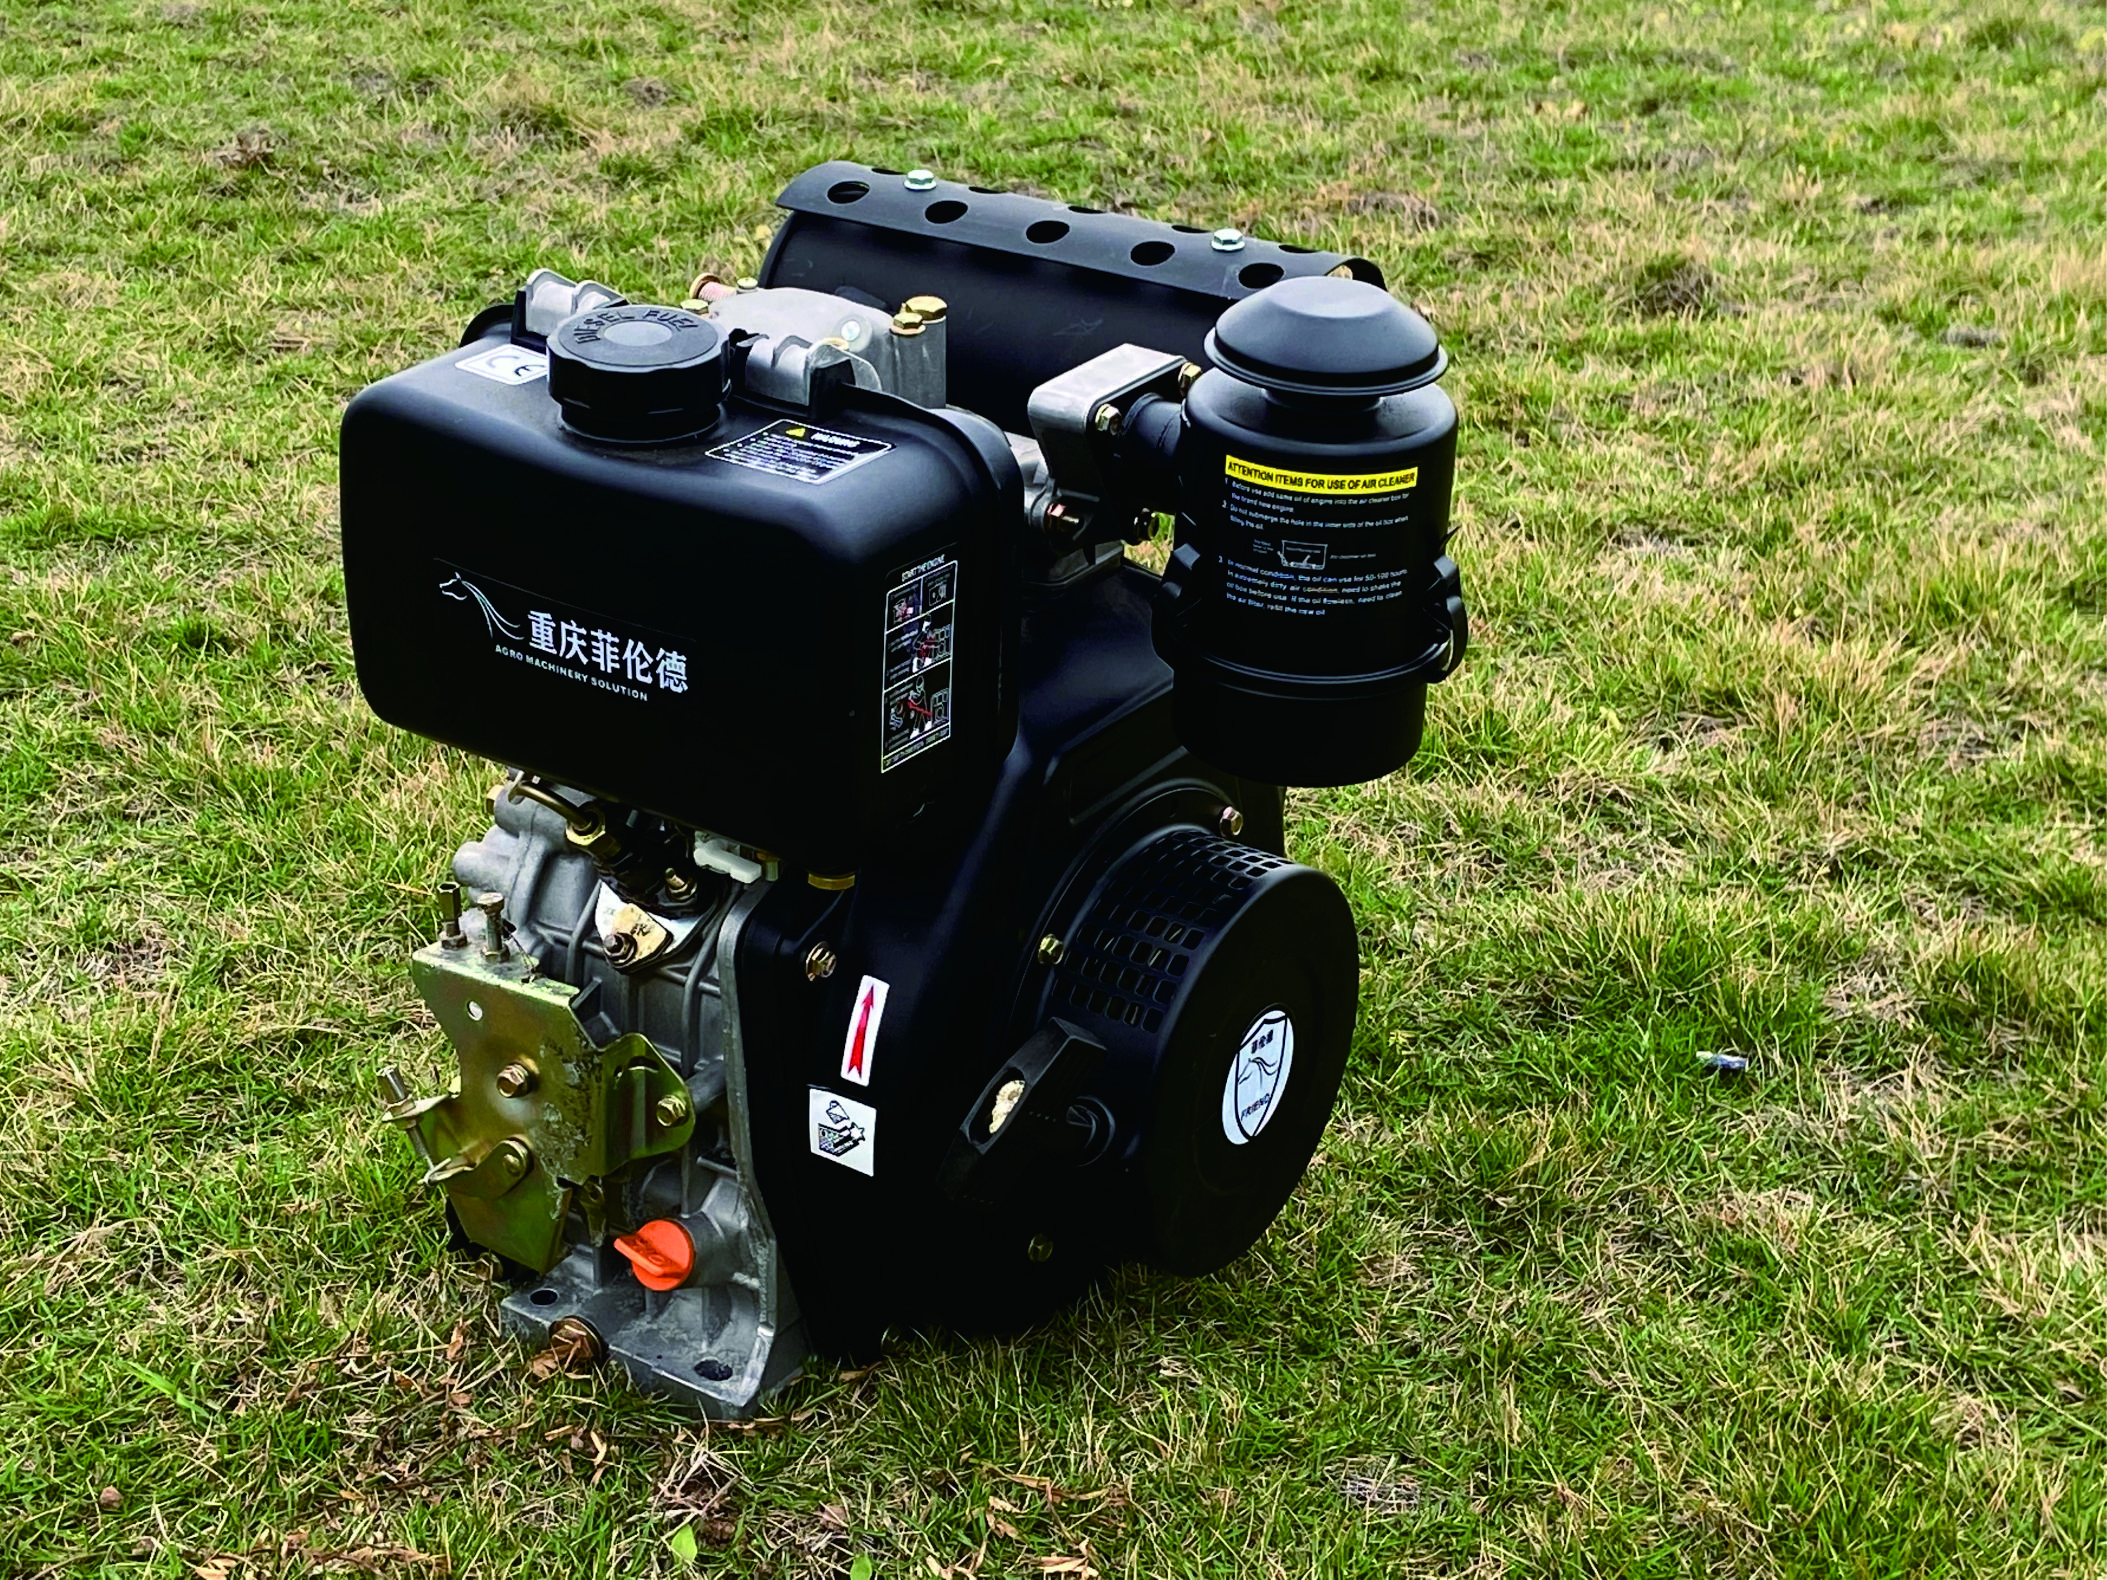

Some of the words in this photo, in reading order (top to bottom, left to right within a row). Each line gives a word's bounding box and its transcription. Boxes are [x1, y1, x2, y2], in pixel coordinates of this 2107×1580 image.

[643, 310, 698, 332] FUEL
[1228, 462, 1273, 481] ATTENTION
[1276, 475, 1303, 487] ITEMS
[1305, 478, 1324, 488] FOR
[1328, 480, 1346, 489] USE
[1348, 480, 1360, 489] OF
[1361, 480, 1376, 488] AIR
[1378, 473, 1415, 488] CLEANER
[1270, 582, 1287, 590] dirty
[528, 610, 688, 693] 重庆菲伦德
[496, 644, 522, 662] AGRO
[526, 656, 588, 683] MACHINERY
[591, 677, 648, 701] SOLUTION
